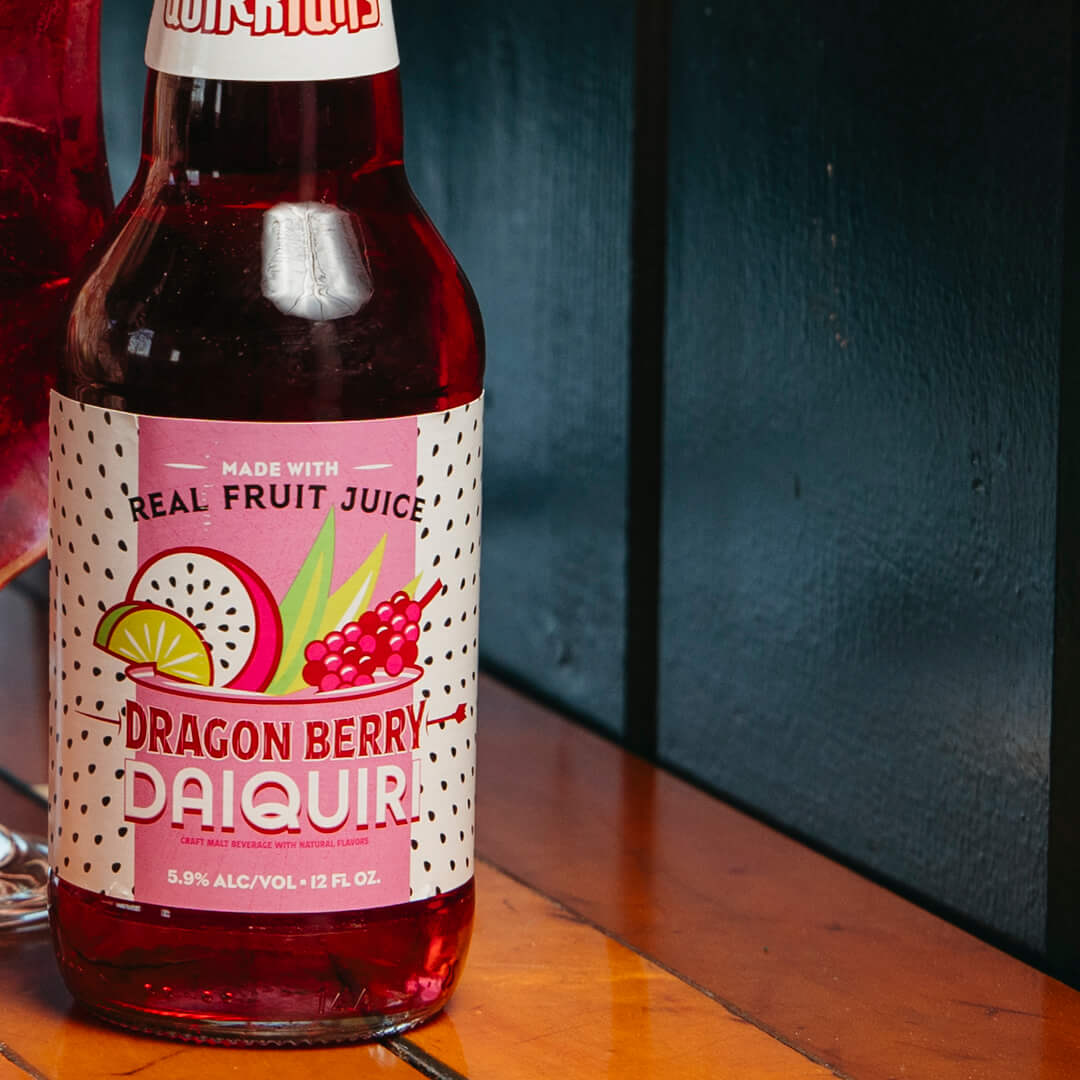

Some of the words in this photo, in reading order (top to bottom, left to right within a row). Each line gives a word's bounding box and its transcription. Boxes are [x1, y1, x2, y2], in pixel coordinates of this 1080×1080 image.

[222, 460, 281, 477] MADE
[287, 460, 339, 477] WITH
[128, 487, 209, 522] REAL
[223, 484, 327, 510] FRUIT
[340, 486, 426, 522] JUICE
[124, 699, 293, 762] DRAGON
[302, 697, 428, 762] BERRY
[123, 758, 422, 835] DAIQUIRI
[180, 836, 204, 846] CRAFT
[207, 839, 229, 848] MALT
[231, 840, 273, 849] BEVERAGE
[274, 841, 297, 849] WITH
[299, 839, 335, 849] NATURAL
[337, 837, 369, 847] FLAVORS
[167, 869, 210, 888] 5.9%
[213, 873, 297, 890] ALC/VOL
[310, 874, 328, 889] 12
[331, 873, 352, 889] FL
[353, 870, 382, 886] OZ.
